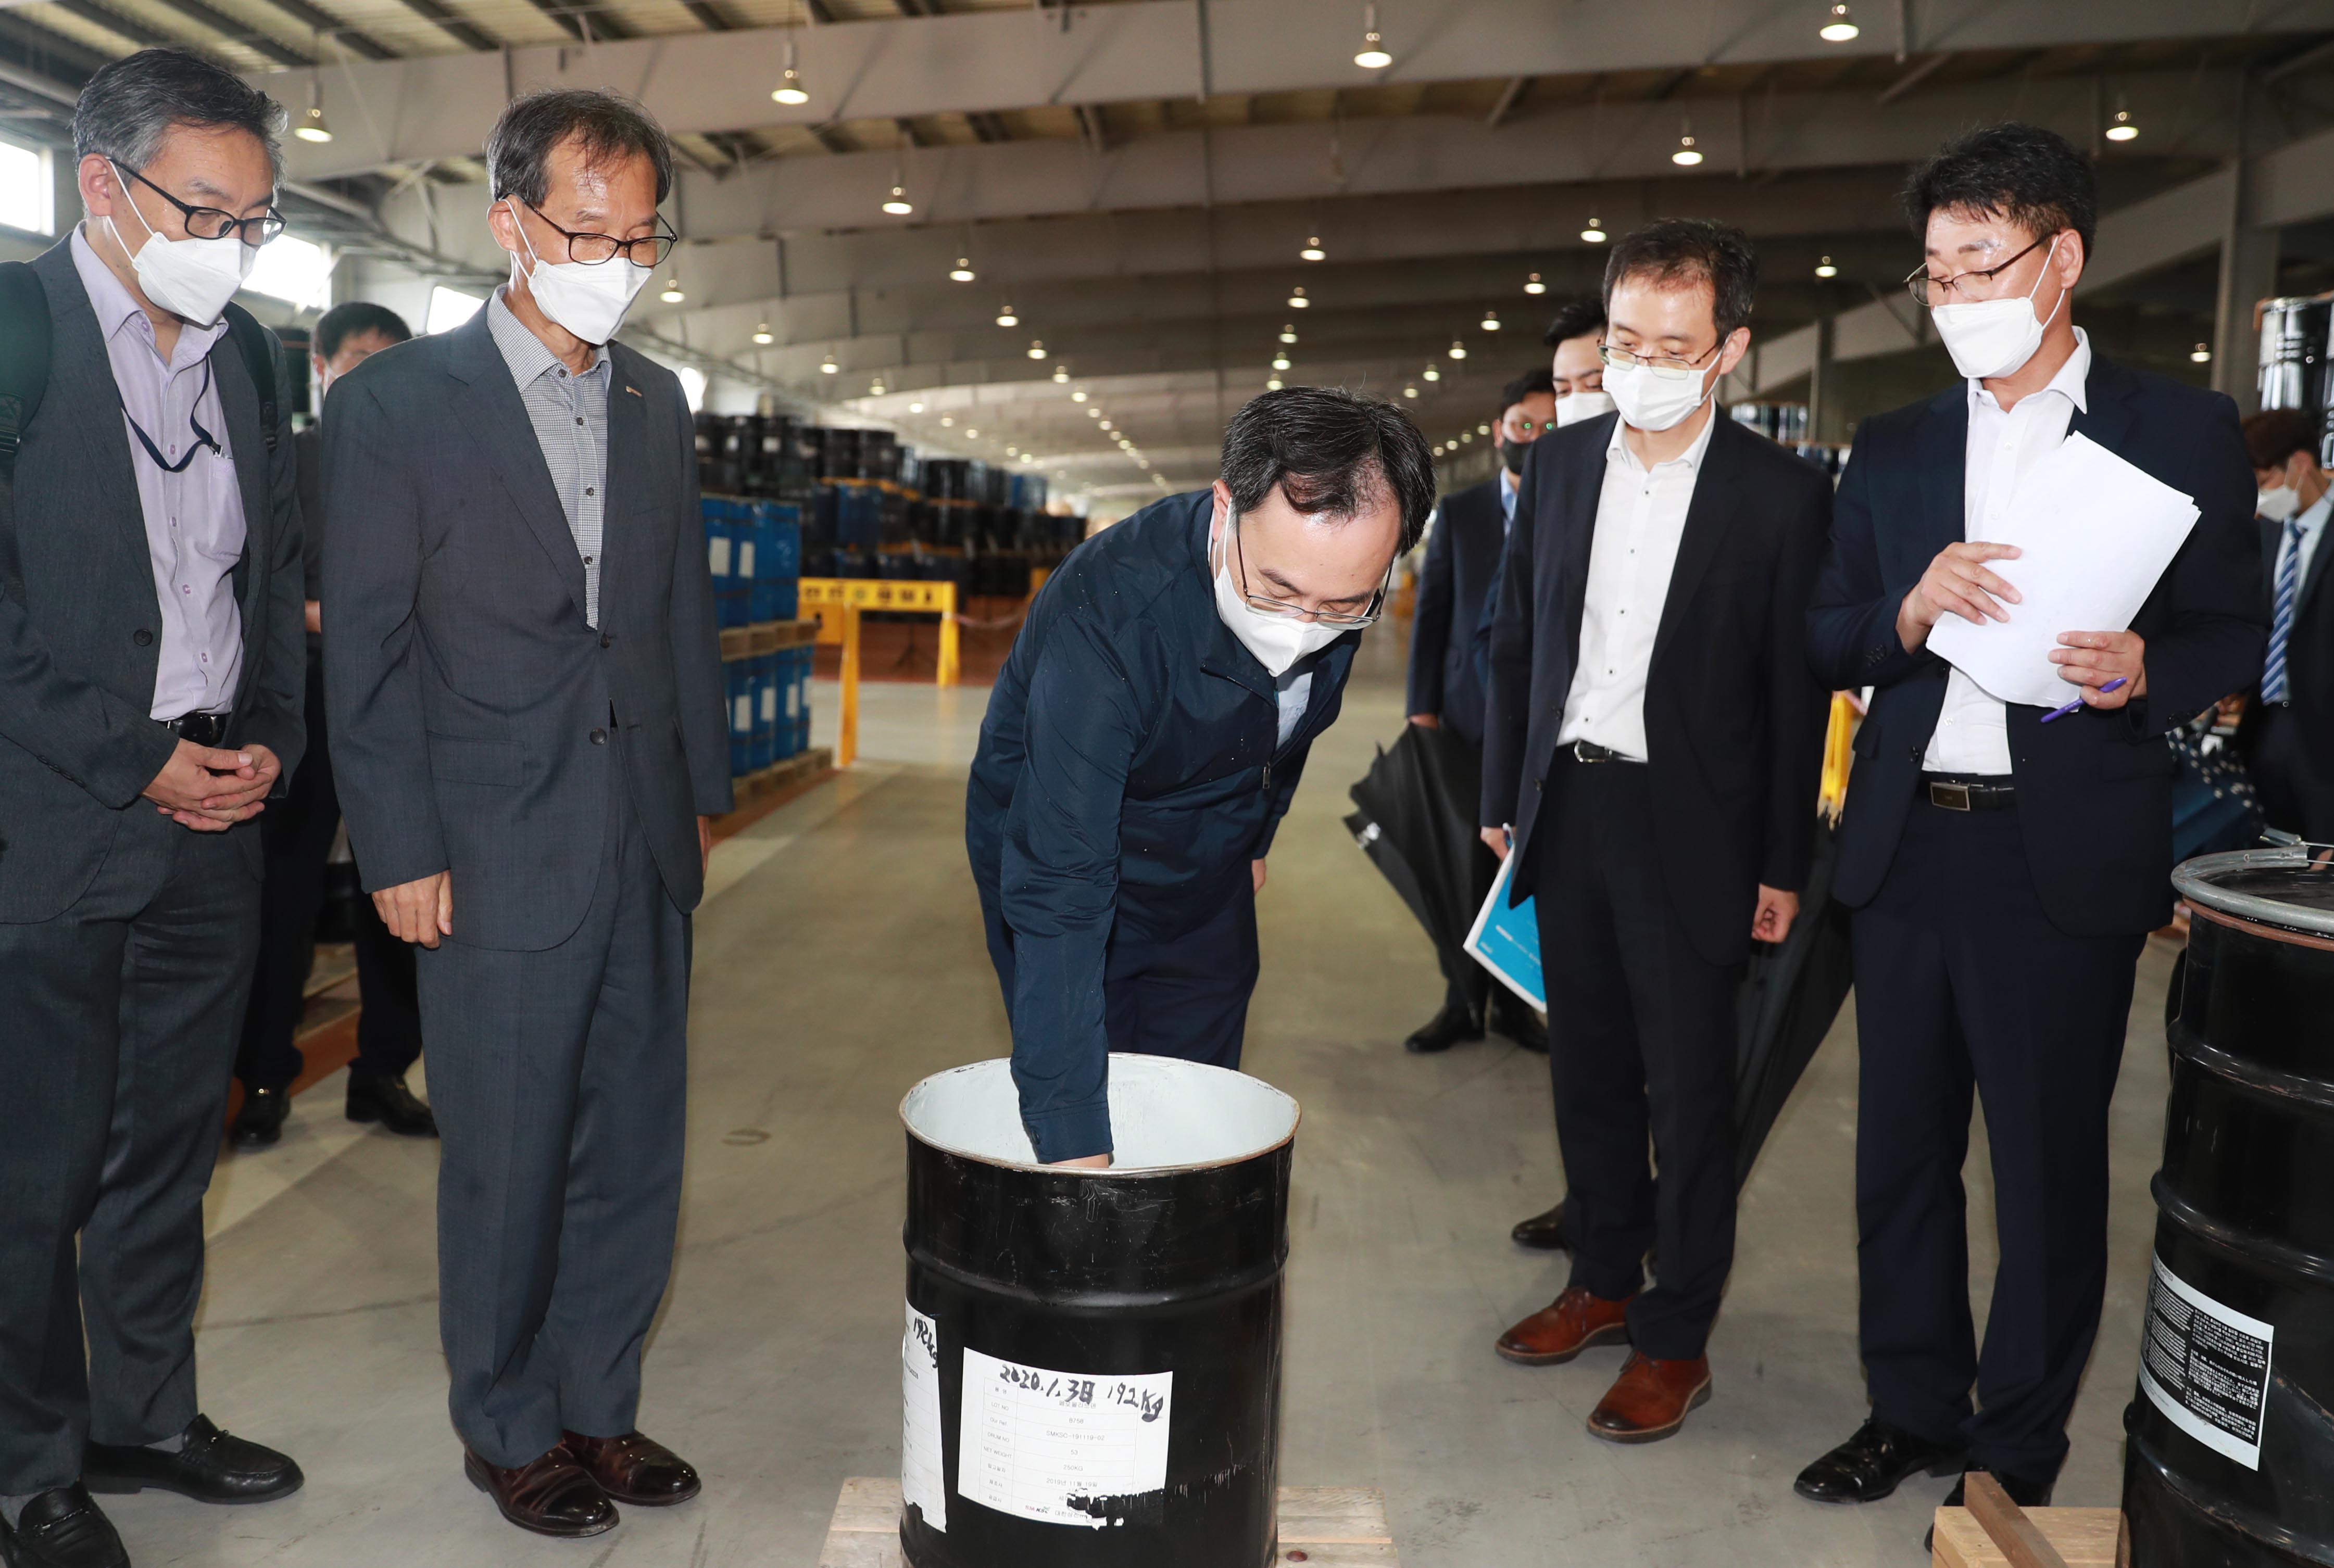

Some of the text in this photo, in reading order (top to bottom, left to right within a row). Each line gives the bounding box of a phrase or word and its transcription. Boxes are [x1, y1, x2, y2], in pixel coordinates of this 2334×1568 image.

[987, 1432, 1001, 1440] DRUM
[994, 1449, 1012, 1459] WEIGHT
[1046, 1477, 1066, 1486] 2019년
